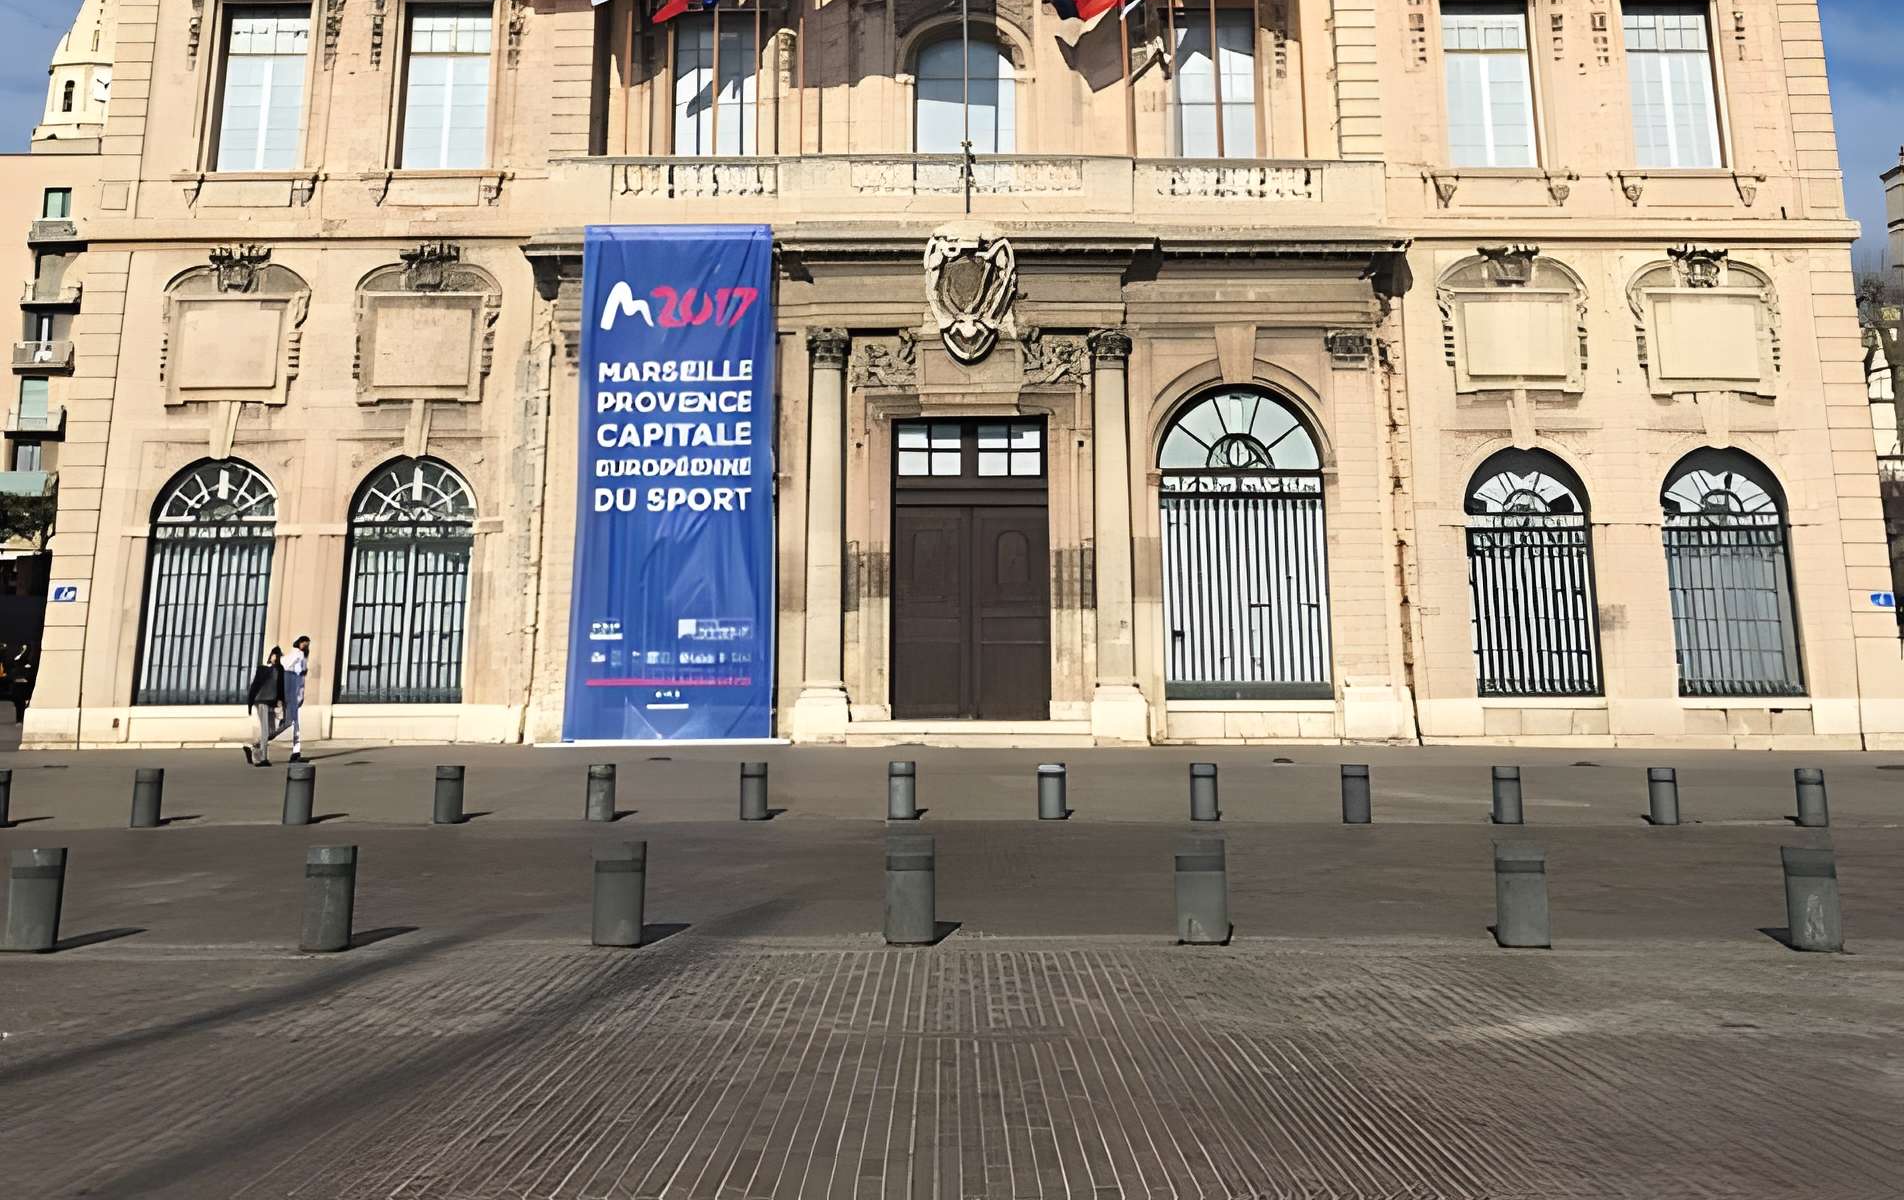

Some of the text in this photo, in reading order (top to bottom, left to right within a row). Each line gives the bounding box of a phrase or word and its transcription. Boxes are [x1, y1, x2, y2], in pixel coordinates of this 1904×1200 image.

[598, 359, 752, 383] MARSEILLE
[597, 390, 752, 414] PROVENCE
[596, 421, 752, 448] CAPITALE
[594, 487, 752, 512] DU SPORT
